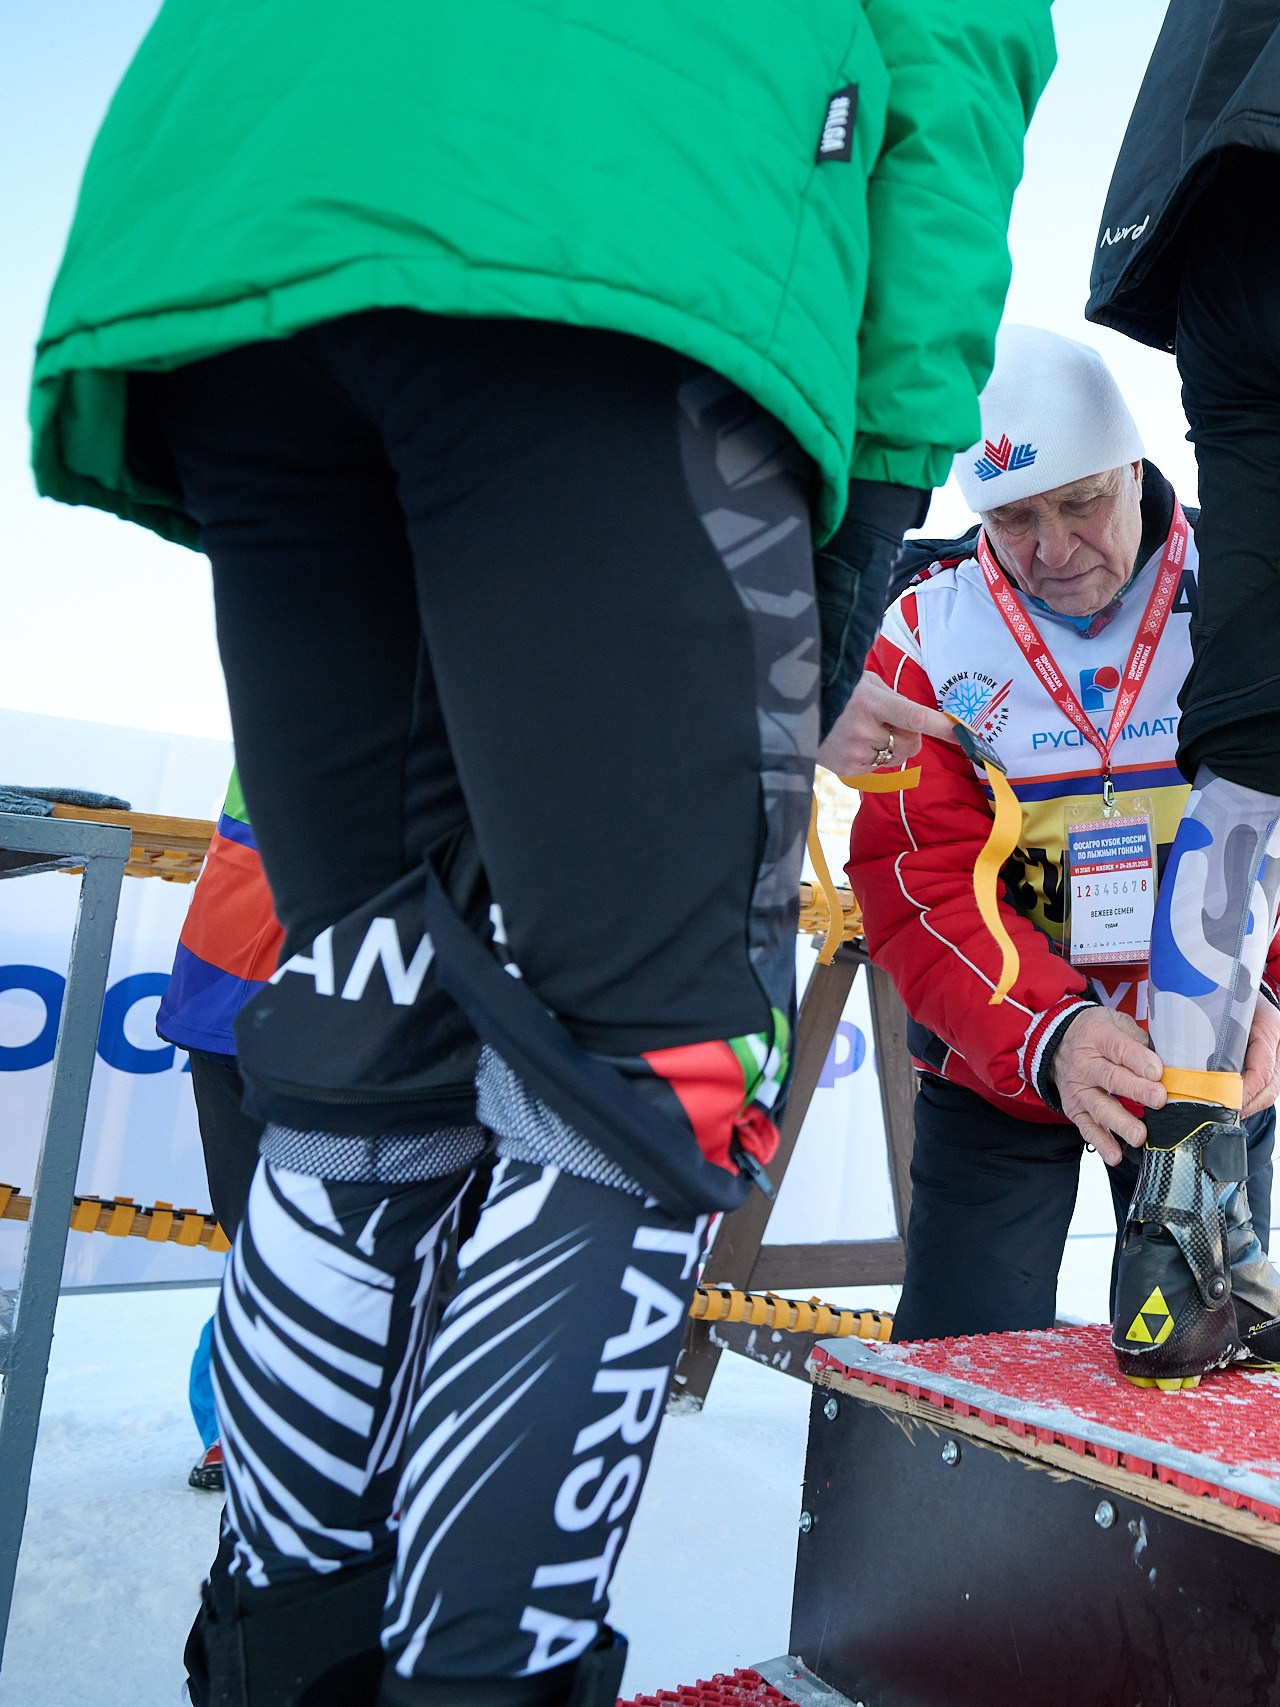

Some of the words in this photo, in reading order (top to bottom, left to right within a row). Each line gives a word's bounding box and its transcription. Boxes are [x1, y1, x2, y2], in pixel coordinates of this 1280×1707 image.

[1099, 214, 1150, 249] Nord
[939, 671, 969, 697] ЛЫЖНЫХ
[972, 672, 998, 690] ГОНОК
[1073, 840, 1101, 851] ФОСАГРО
[1101, 837, 1122, 848] КУБОК
[1122, 834, 1147, 845] РОССИИ
[1077, 851, 1086, 860] ПО
[1087, 848, 1118, 859] ЛЫЖНЫМ
[1118, 845, 1144, 855] ГОНКАМ
[1077, 886, 1082, 898] 1
[1085, 885, 1091, 897] 2
[1094, 884, 1100, 896] 3
[1103, 883, 1110, 896] 4
[1112, 882, 1119, 895] 5
[1122, 881, 1128, 894] 6
[1131, 880, 1137, 893] 7
[1141, 879, 1147, 892] 8
[1114, 906, 1134, 916] СЕМЕН
